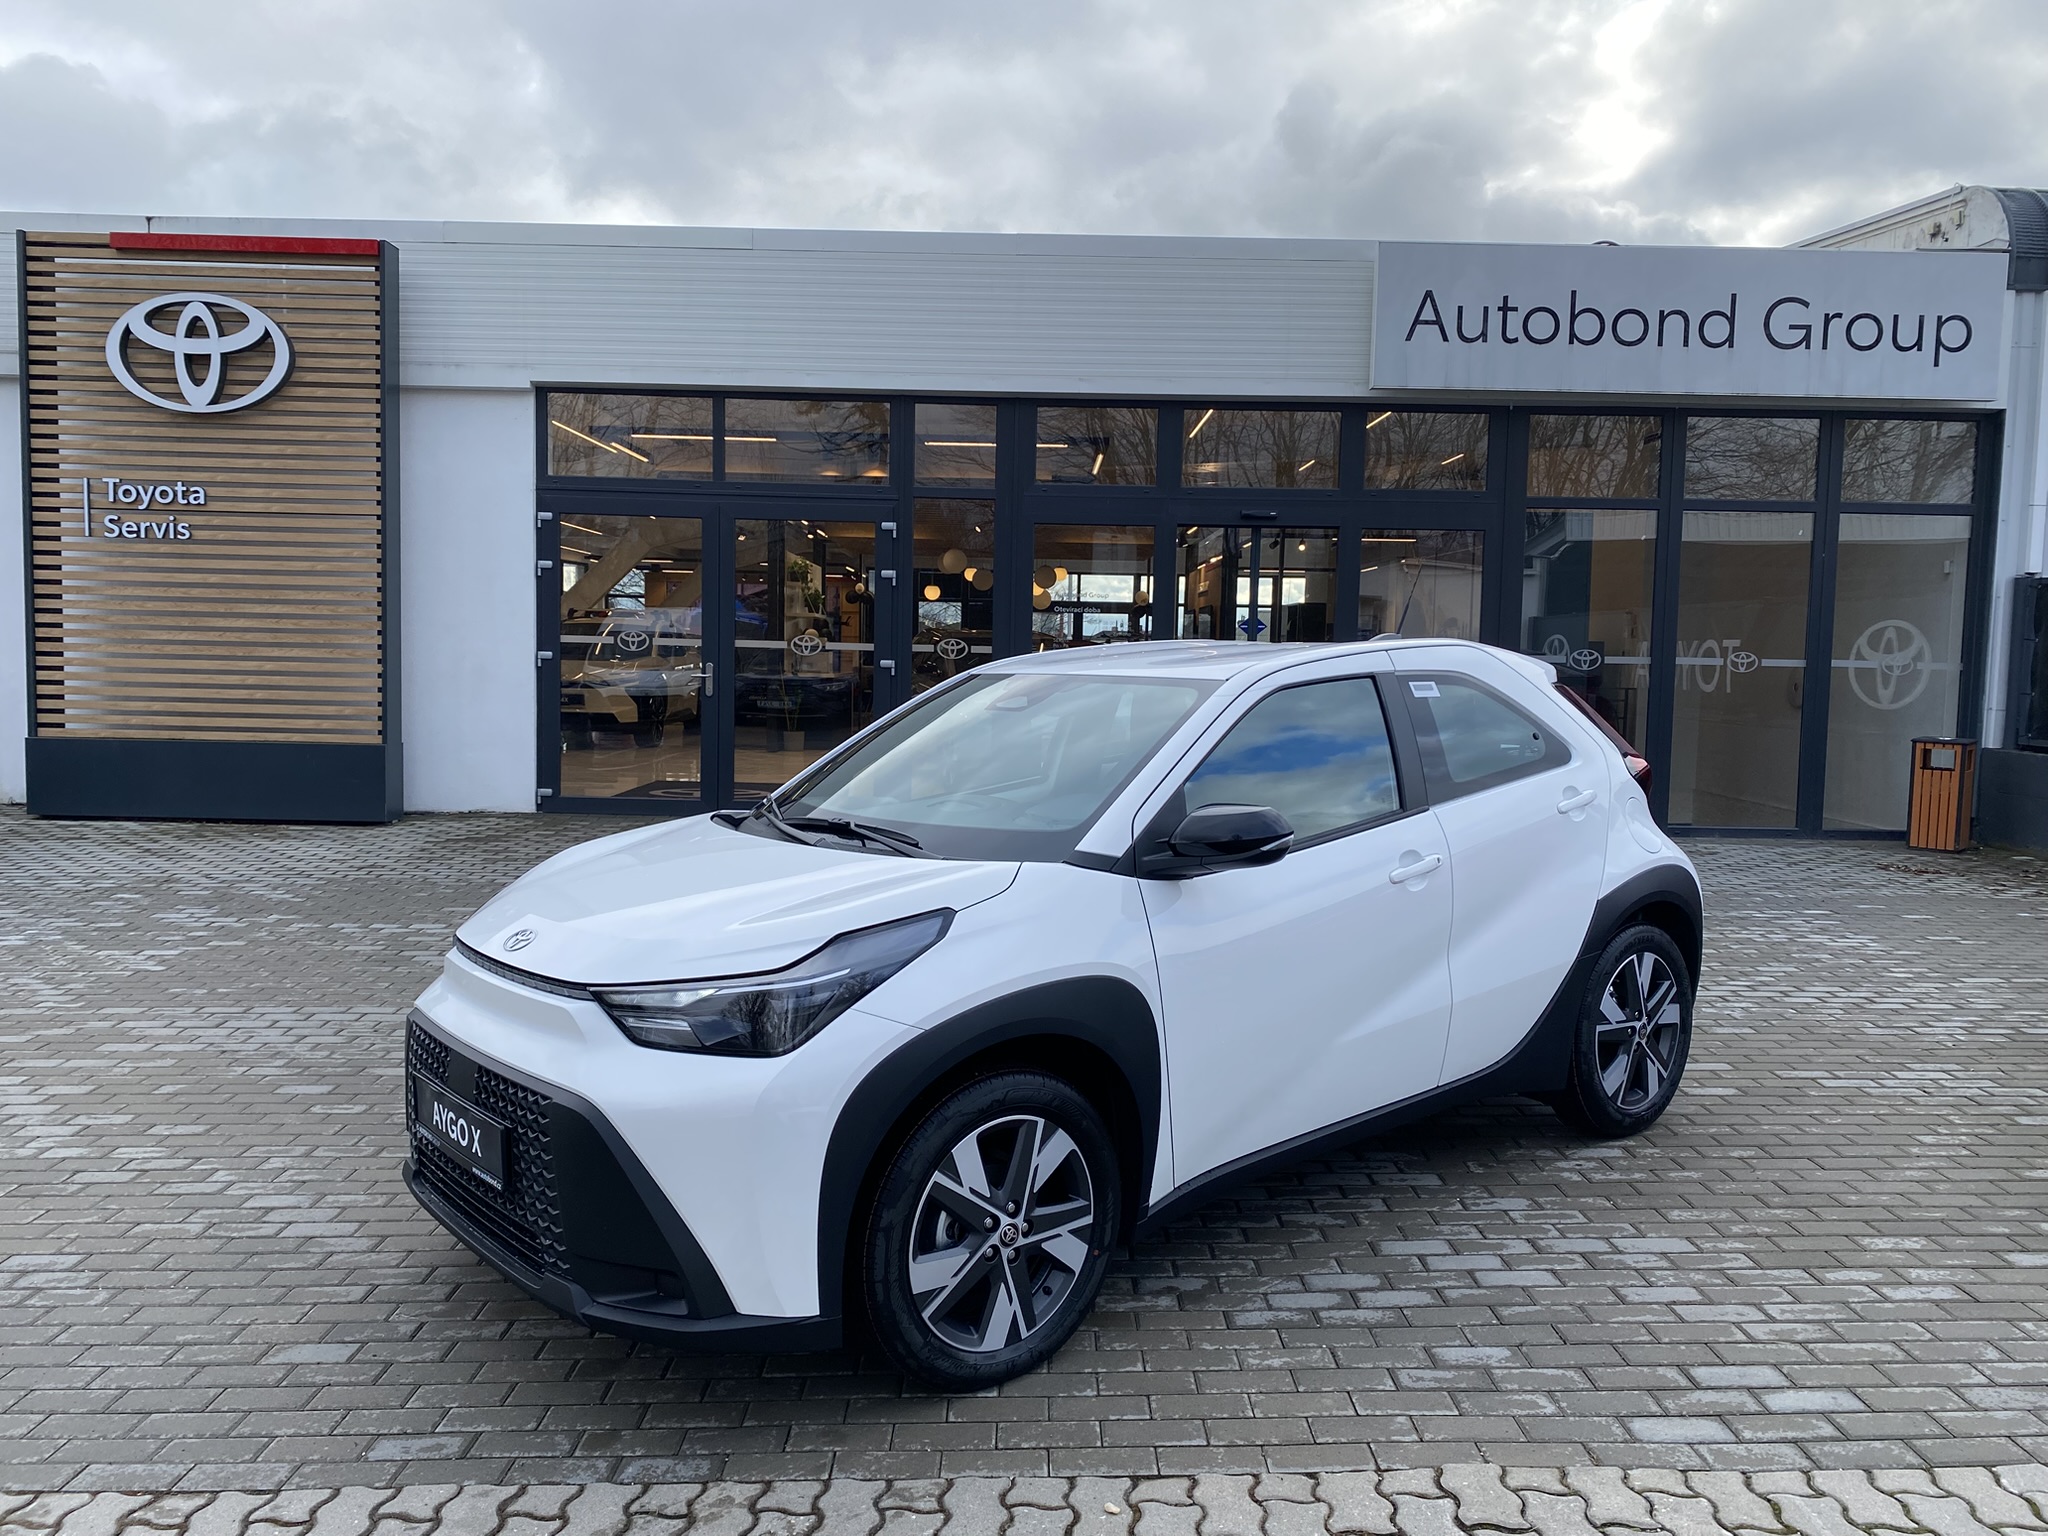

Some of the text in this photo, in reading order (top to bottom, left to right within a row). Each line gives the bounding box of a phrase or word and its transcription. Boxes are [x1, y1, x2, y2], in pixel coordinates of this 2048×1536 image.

[1404, 289, 1973, 367] Autobond Group
[102, 477, 206, 510] Toyota
[103, 514, 192, 540] Servis
[433, 1101, 469, 1147] AYGO
[471, 1125, 482, 1157] X
